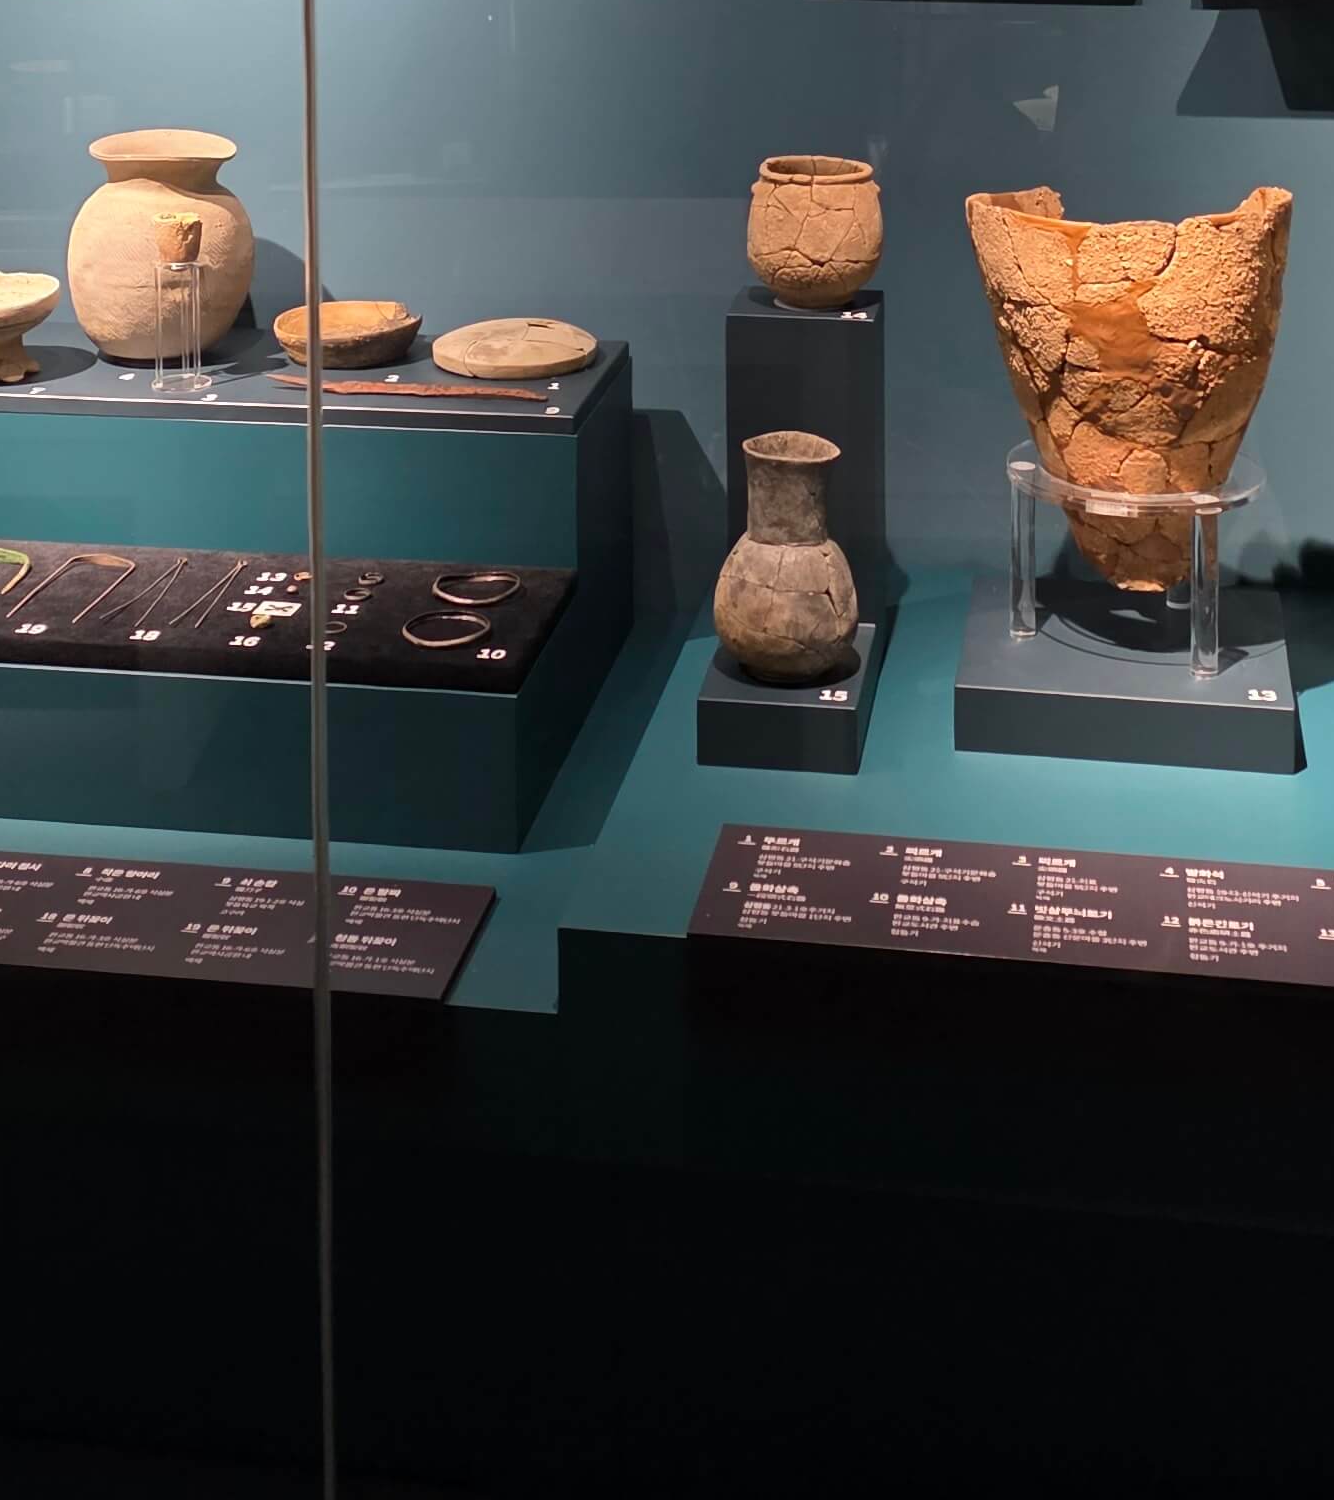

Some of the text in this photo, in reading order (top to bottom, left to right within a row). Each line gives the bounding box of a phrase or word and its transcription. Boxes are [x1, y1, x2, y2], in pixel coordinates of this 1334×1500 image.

[256, 572, 287, 581] 13
[244, 586, 273, 595] 14
[331, 604, 359, 614] 11
[15, 624, 47, 634] 19
[130, 630, 160, 640] 18
[229, 636, 260, 646] 16
[477, 649, 506, 659] 10
[819, 690, 847, 701] 15
[1249, 689, 1277, 701] 13
